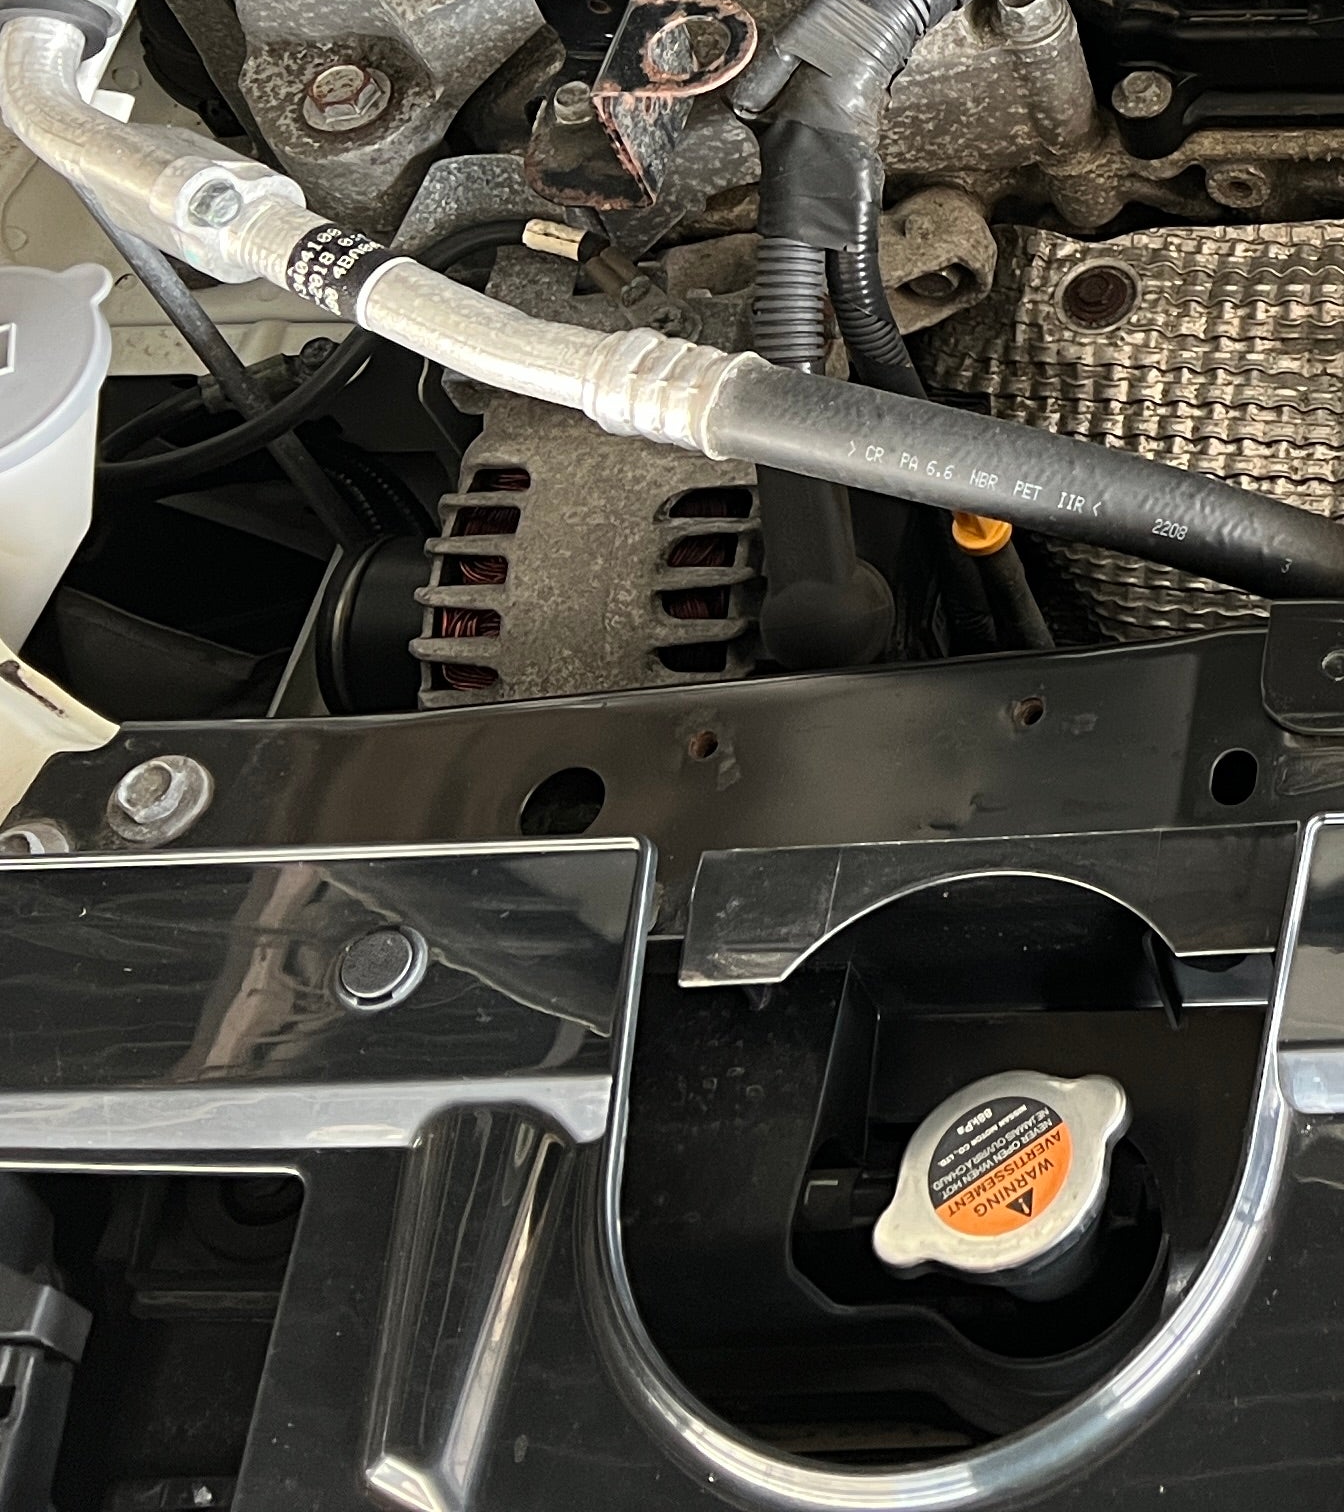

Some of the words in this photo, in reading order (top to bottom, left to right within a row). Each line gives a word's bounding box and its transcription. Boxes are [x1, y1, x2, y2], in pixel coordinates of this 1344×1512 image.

[865, 447, 885, 464] CR
[899, 452, 919, 471] PA
[926, 460, 955, 481] 6.6
[969, 469, 999, 491] NBR
[1012, 480, 1043, 502] PET
[1057, 491, 1086, 514] IIR
[1151, 519, 1189, 541] 2208
[1021, 1119, 1053, 1144] NEVER
[992, 1140, 1020, 1162] OPEN
[947, 1130, 1061, 1217] AVERTISSEMENT
[963, 1159, 994, 1183] WHEN
[974, 1157, 1054, 1217] WARNING
